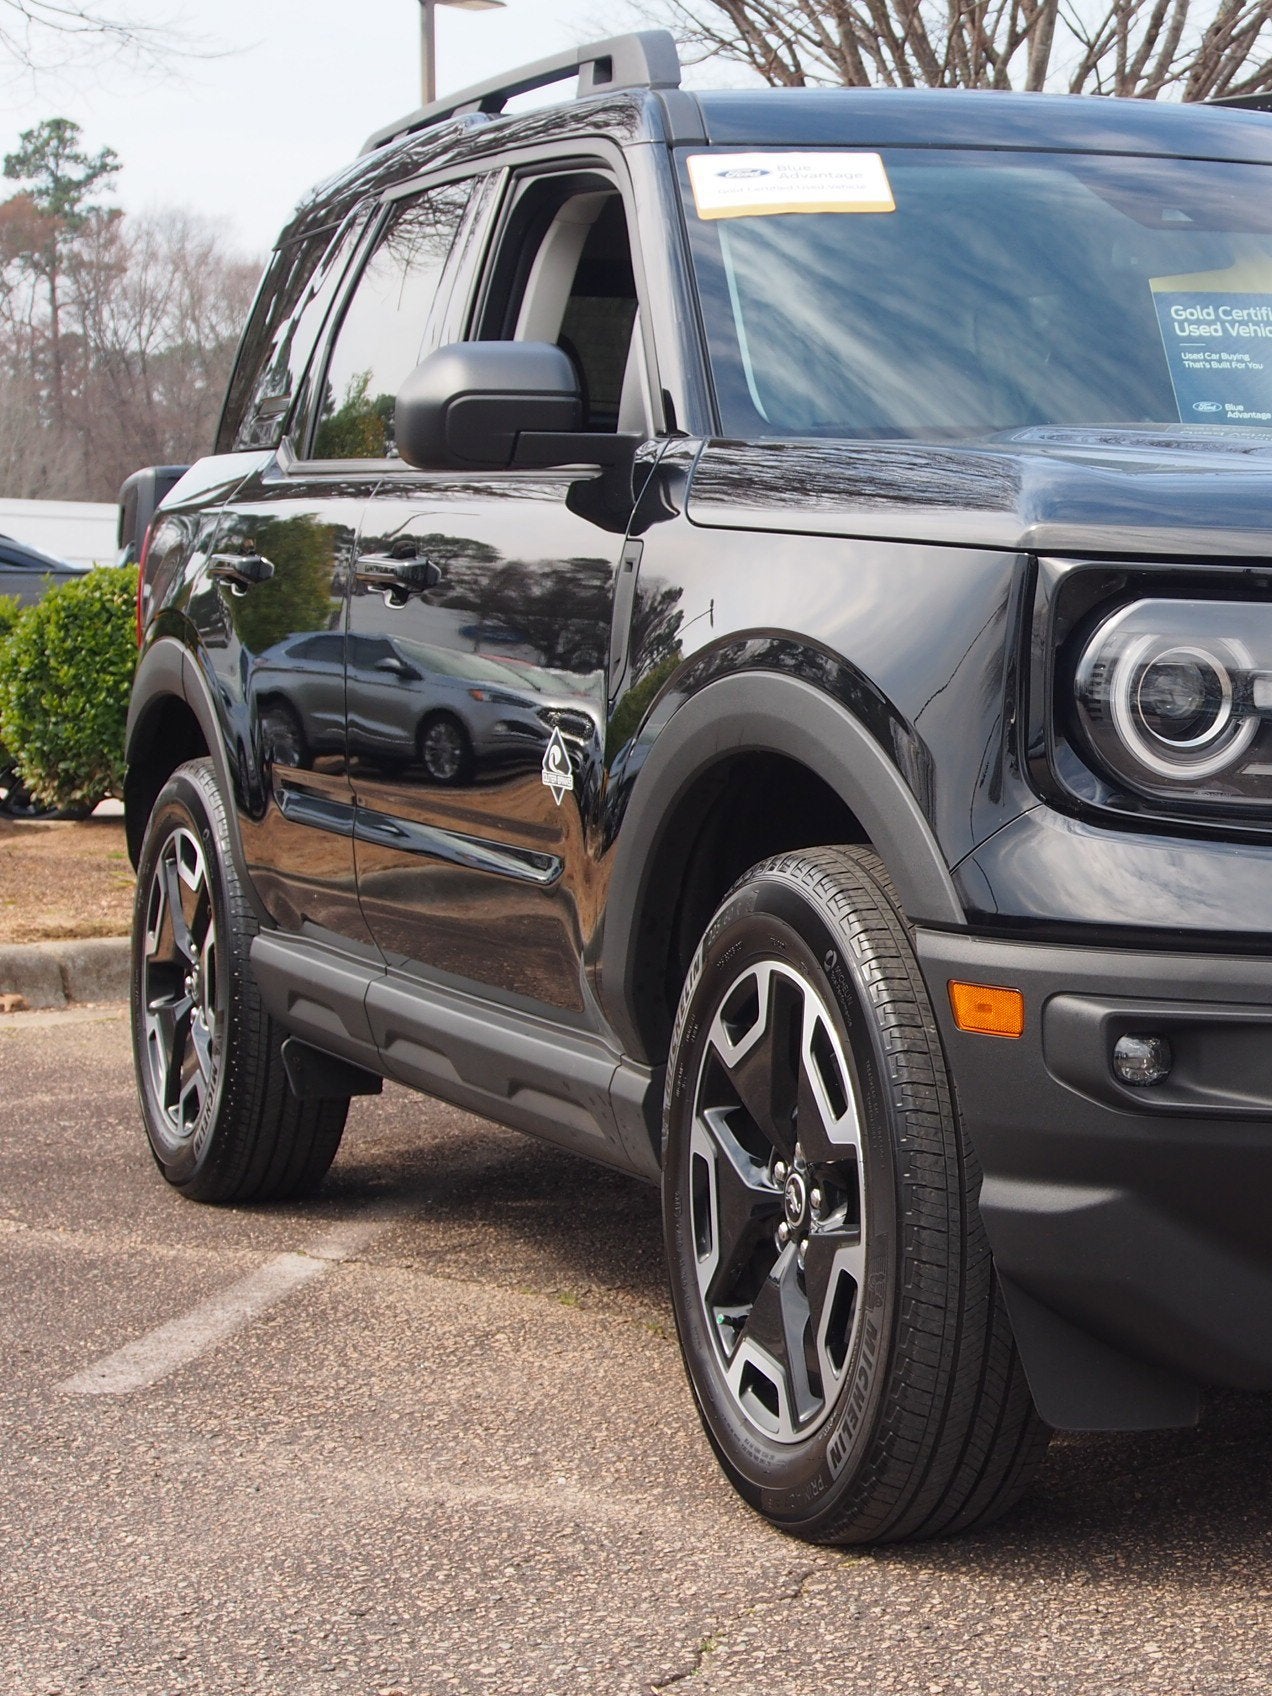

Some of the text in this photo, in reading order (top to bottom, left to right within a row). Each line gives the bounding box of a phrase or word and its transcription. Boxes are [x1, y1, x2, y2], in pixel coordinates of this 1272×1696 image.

[779, 172, 864, 180] Advantage
[1170, 305, 1215, 320] Gold
[1174, 322, 1223, 336] Used
[1181, 352, 1250, 361] Used Car Buying
[1183, 360, 1210, 368] That's
[1211, 361, 1231, 369] Built
[1231, 361, 1246, 369] For
[1225, 403, 1244, 411] Blue
[1227, 411, 1272, 420] Advantage
[194, 1064, 218, 1155] MICHELIN
[829, 1318, 878, 1469] MICHELIN
